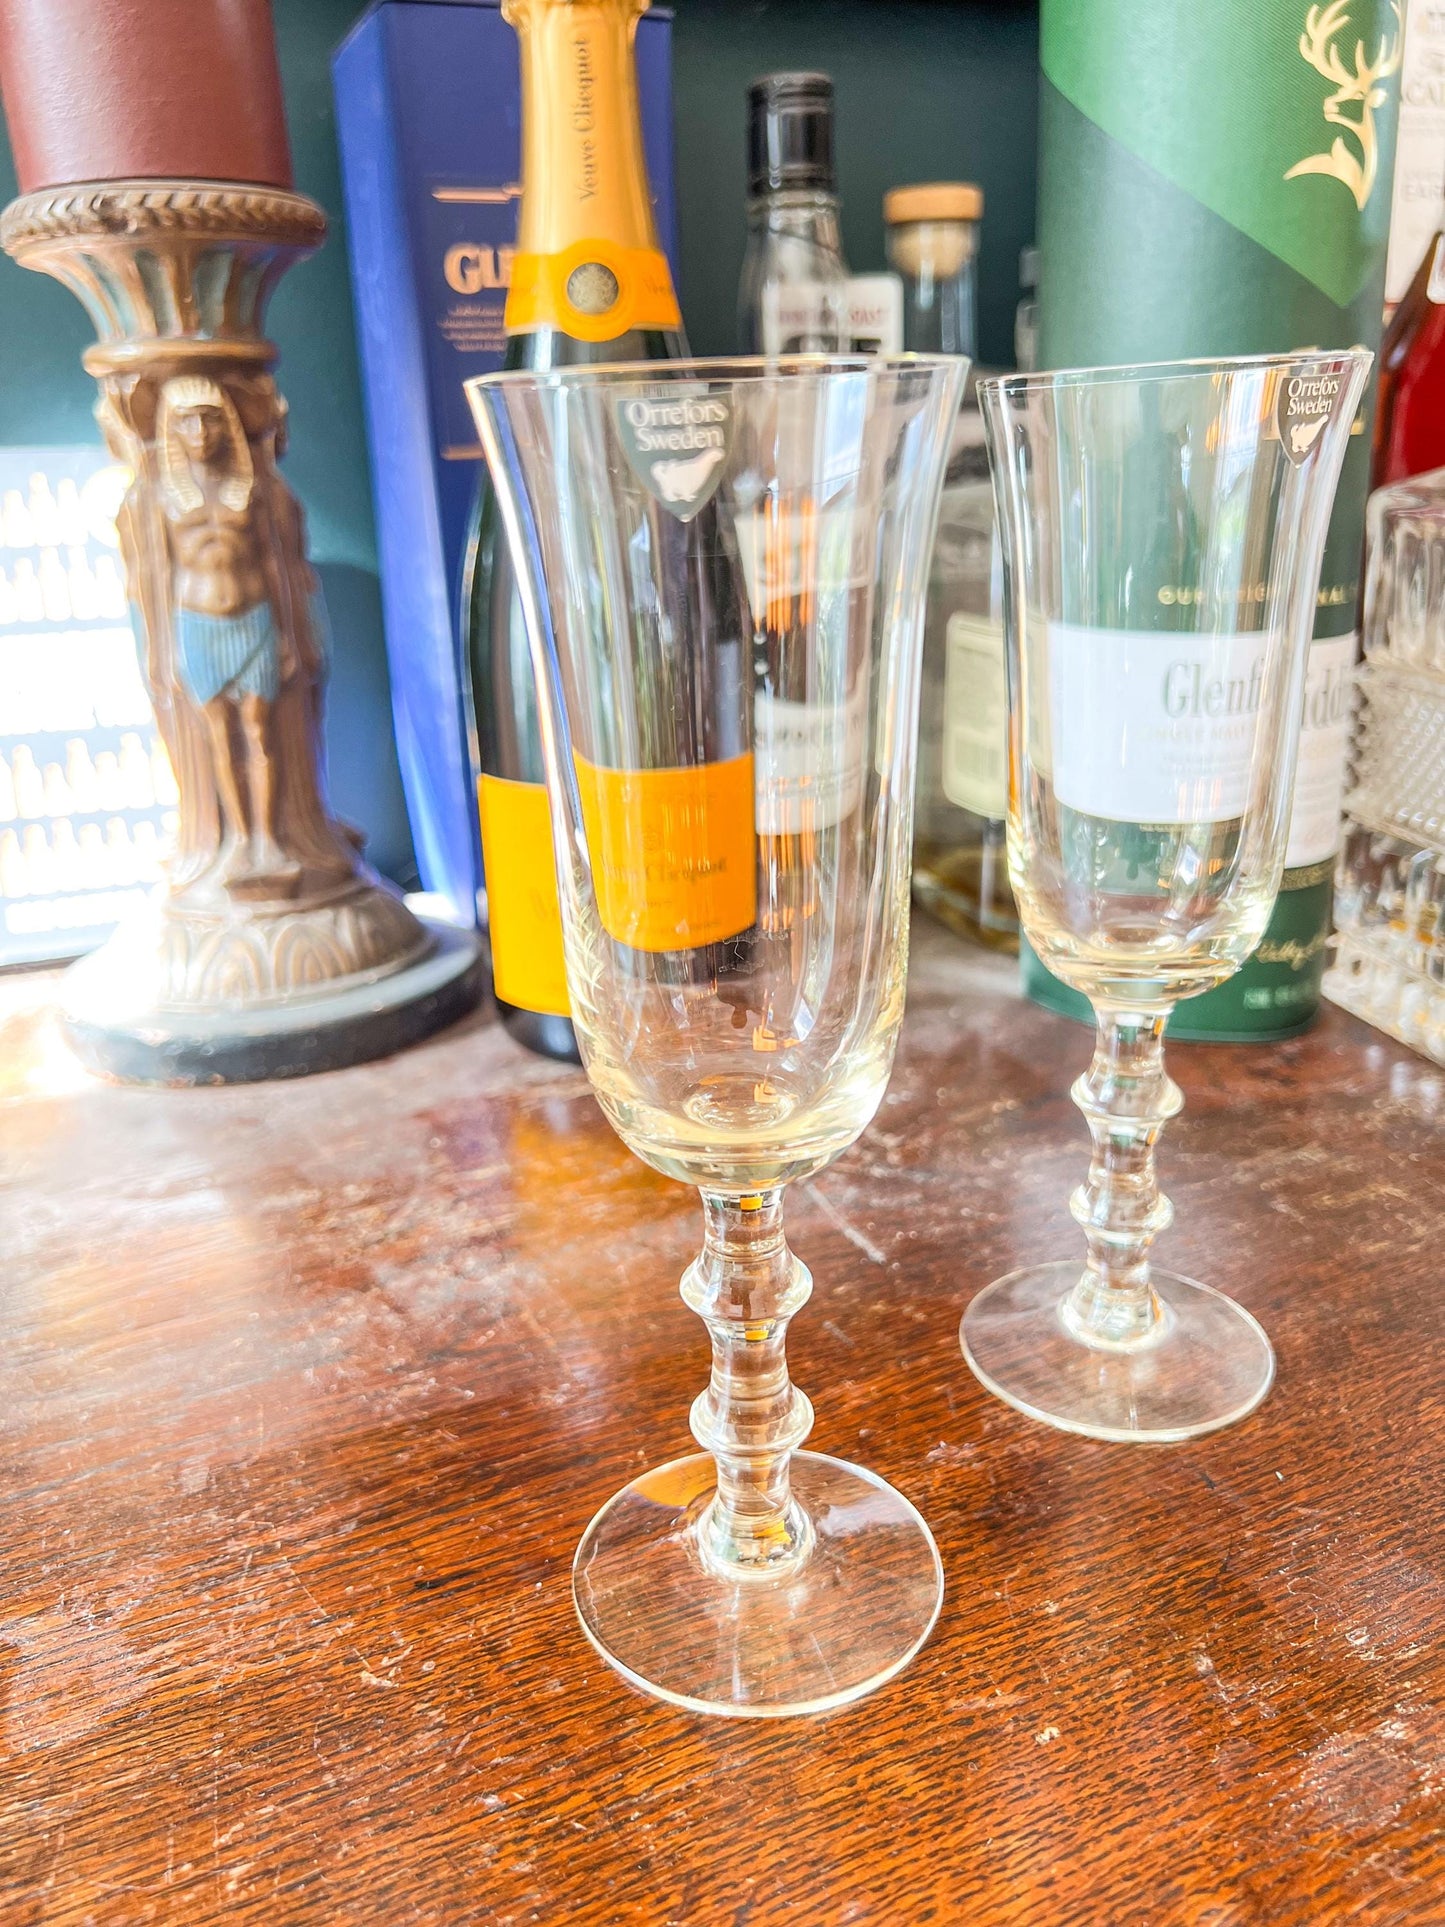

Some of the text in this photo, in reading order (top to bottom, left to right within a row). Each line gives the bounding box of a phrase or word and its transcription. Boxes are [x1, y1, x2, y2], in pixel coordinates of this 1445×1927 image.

[573, 38, 597, 200] Veuve Clicquot
[1288, 377, 1339, 398] Orrefors
[627, 399, 727, 428] Orrefors
[1287, 396, 1332, 416] Sweden
[637, 425, 722, 452] Sweden
